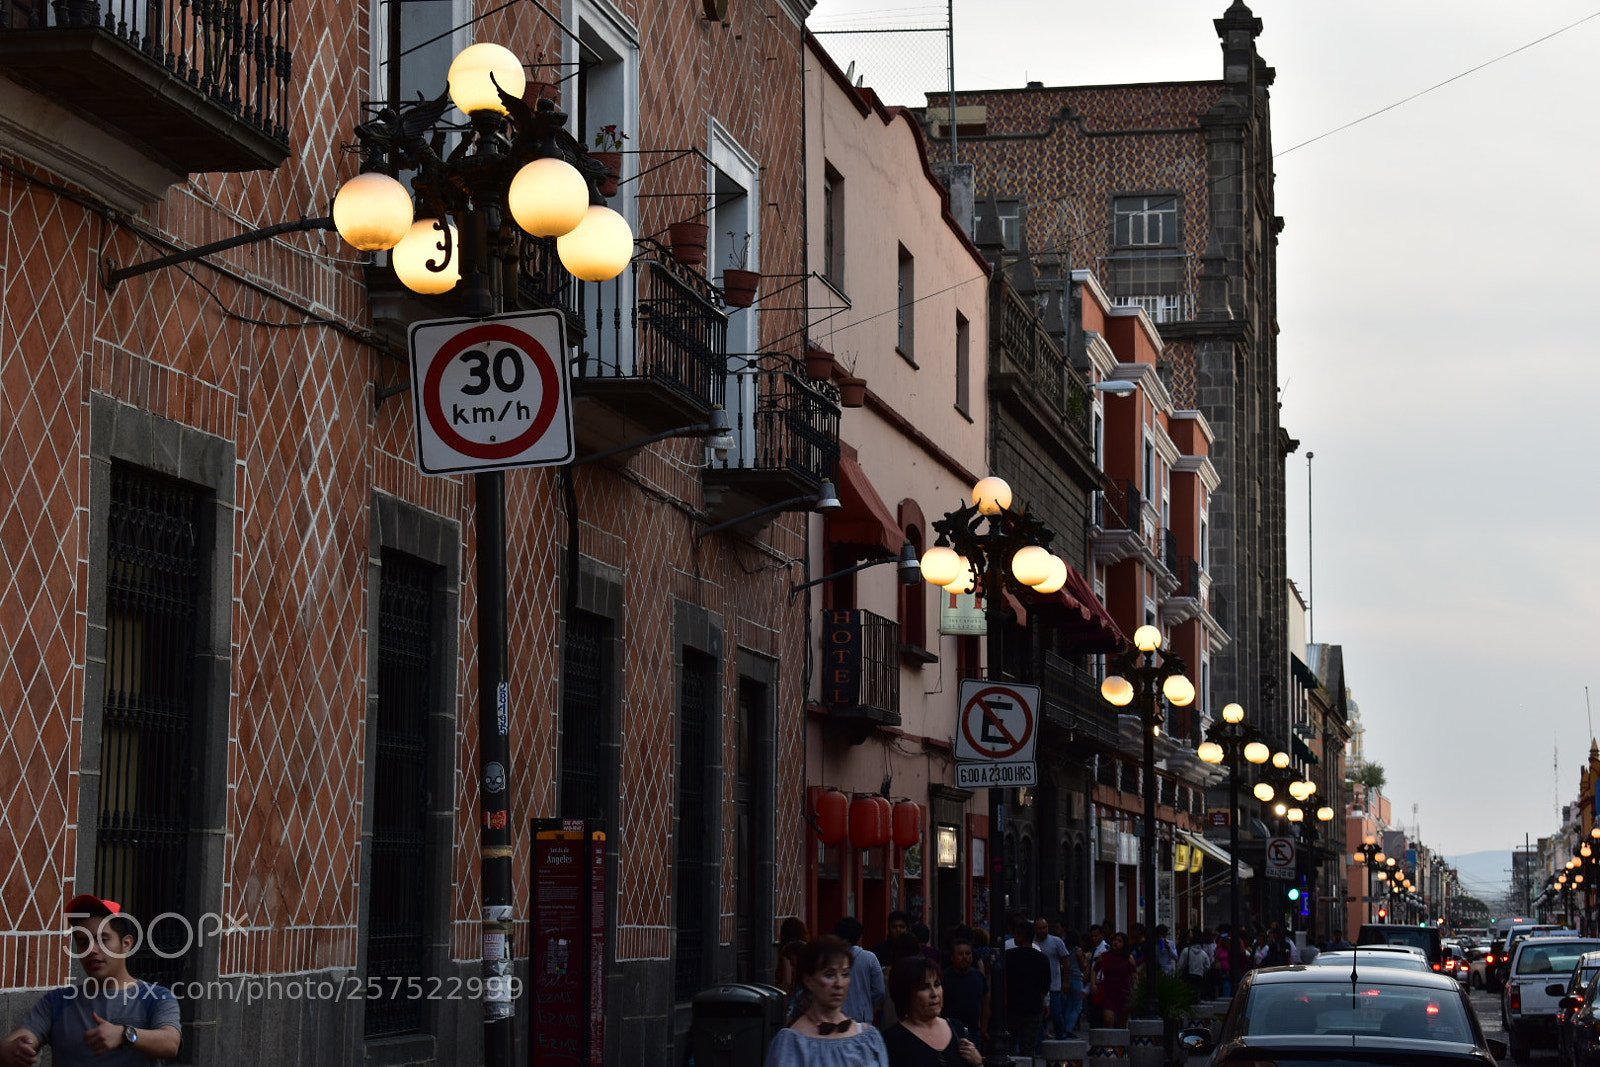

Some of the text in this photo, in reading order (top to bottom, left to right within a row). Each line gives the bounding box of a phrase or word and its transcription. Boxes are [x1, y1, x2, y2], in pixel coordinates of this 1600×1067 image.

[459, 347, 525, 395] 30
[452, 400, 531, 425] km/h
[831, 610, 852, 704] HOTEL
[960, 765, 1032, 783] 6:00 A 23:00 HRS
